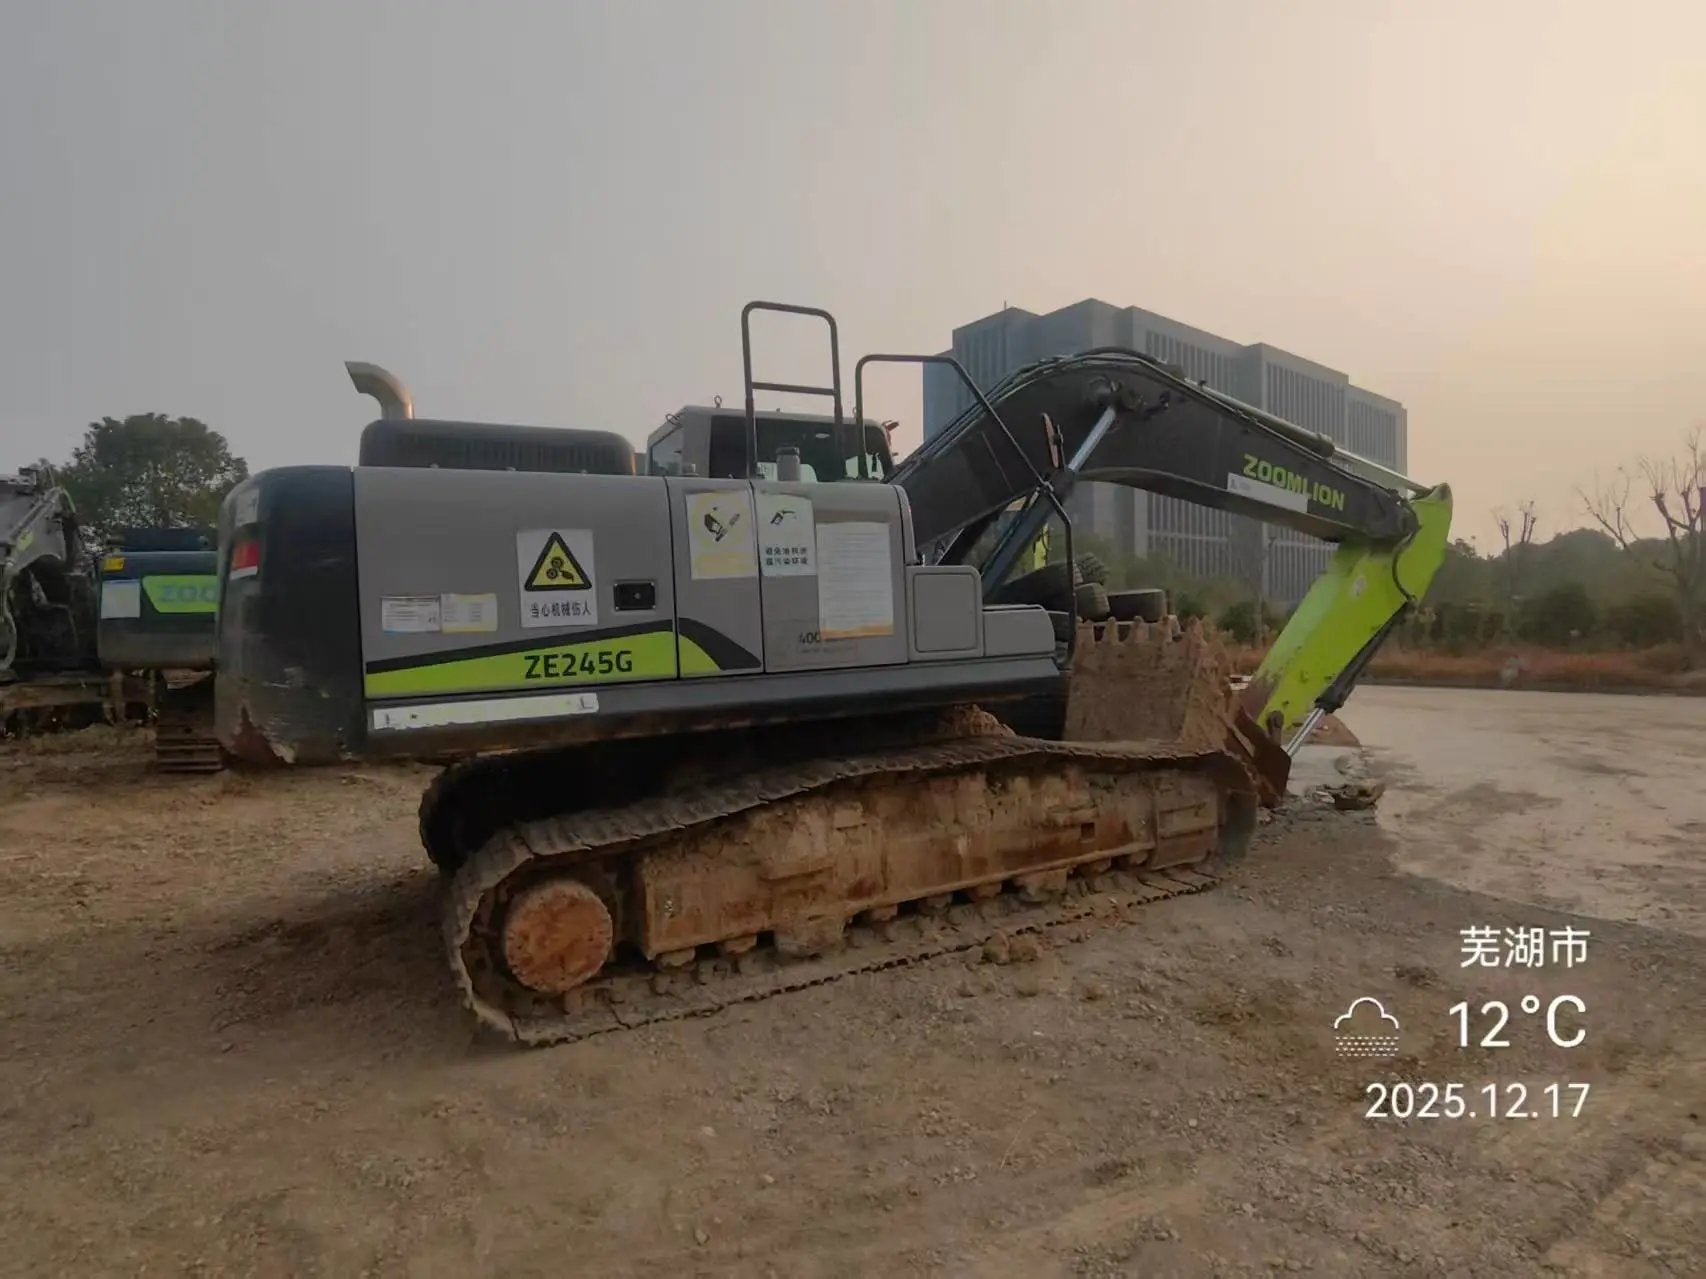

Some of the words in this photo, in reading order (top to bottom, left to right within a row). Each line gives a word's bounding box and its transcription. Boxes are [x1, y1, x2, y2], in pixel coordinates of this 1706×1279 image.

[1242, 453, 1345, 512] ZOOMLION
[531, 601, 592, 618] 当心机械伤人
[524, 650, 633, 679] ZE245G
